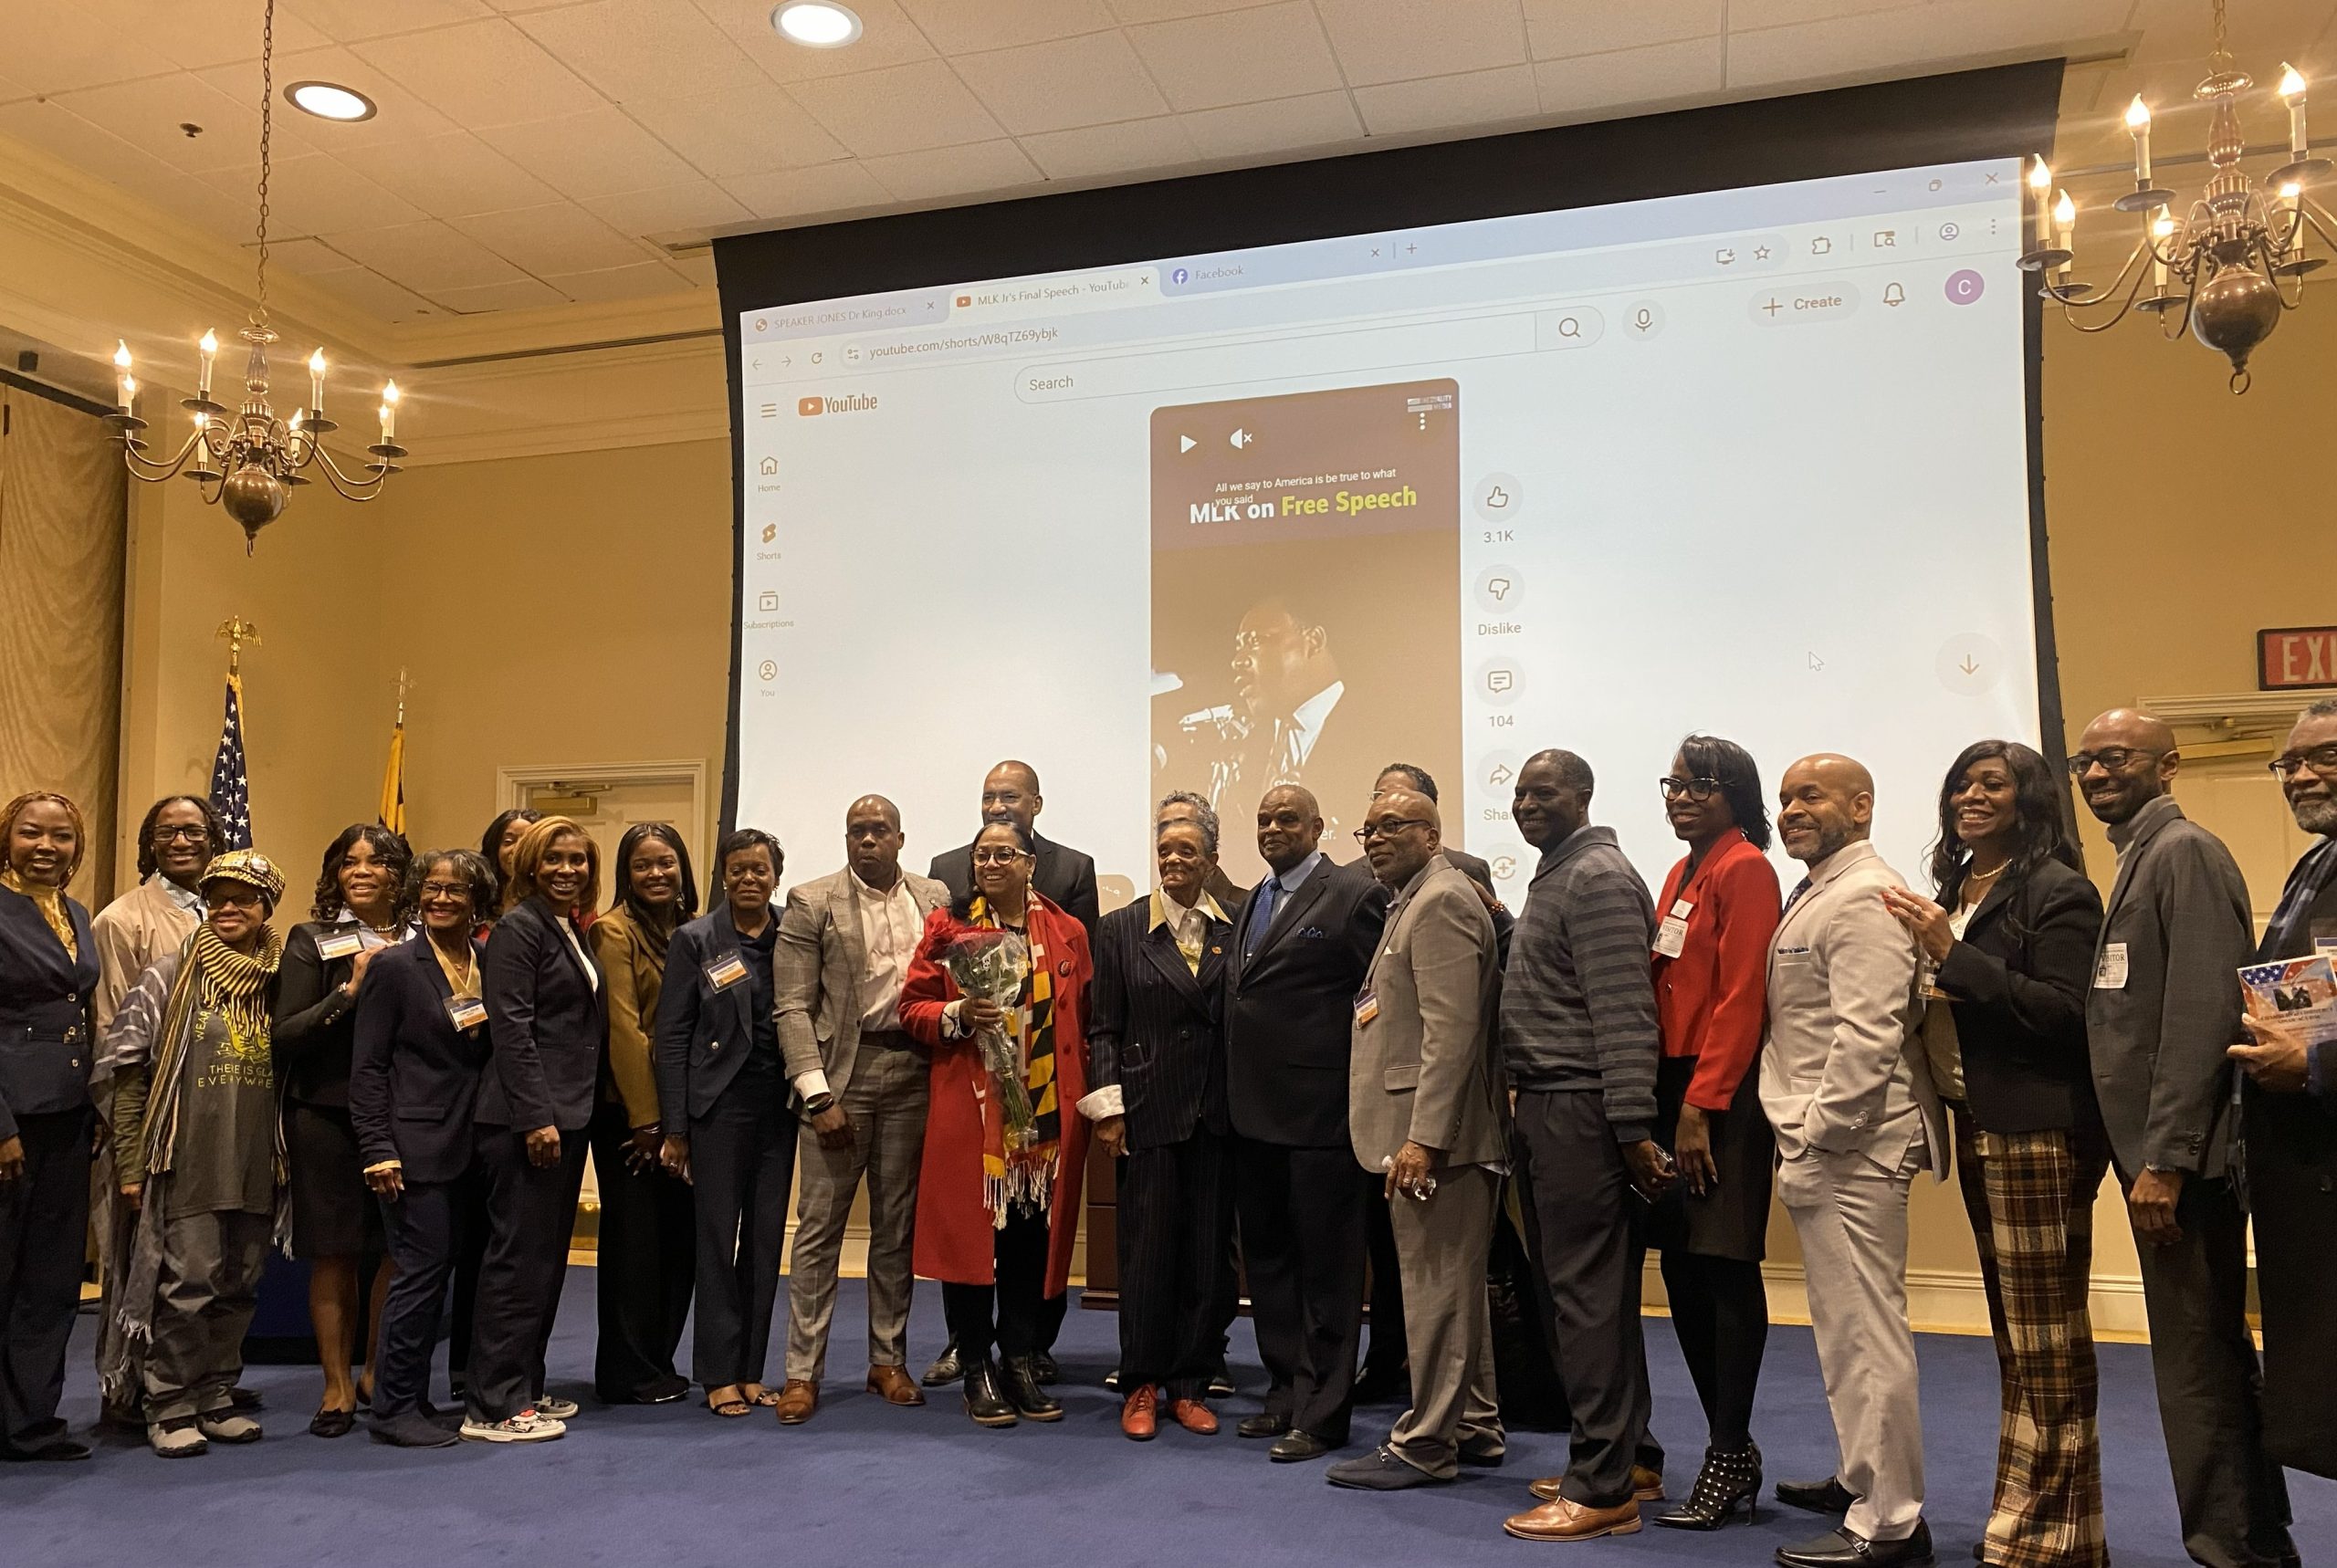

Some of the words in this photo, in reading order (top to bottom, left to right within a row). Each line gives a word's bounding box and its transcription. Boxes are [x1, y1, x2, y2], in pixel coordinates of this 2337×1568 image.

[1194, 265, 1244, 280] Facebook
[1957, 279, 1972, 296] C
[978, 294, 999, 306] MLK
[1001, 291, 1016, 303] Jr's
[1019, 288, 1042, 300] Final
[1043, 285, 1079, 299] Speech
[1793, 294, 1842, 310] Create
[774, 316, 814, 329] SPEAKER
[816, 311, 846, 325] JONES
[848, 310, 859, 320] Dr
[861, 306, 907, 319] King.docx
[1029, 375, 1074, 392] Search
[824, 392, 878, 413] YouTube
[1215, 482, 1228, 493] All
[1229, 483, 1243, 492] we
[1244, 481, 1261, 492] say
[1263, 479, 1273, 489] to
[1273, 476, 1313, 488] America
[1315, 475, 1324, 485] is
[1326, 474, 1337, 484] be
[1339, 472, 1358, 482] true
[1360, 471, 1371, 480] to
[1372, 468, 1397, 479] what
[757, 483, 781, 494] Home
[1189, 502, 1242, 524] MLK
[1247, 502, 1274, 519] on
[1282, 496, 1329, 517] Free
[1336, 486, 1417, 517] Speech
[1215, 497, 1232, 509] you
[1233, 494, 1253, 505] said
[1483, 529, 1514, 543] 3.1K
[756, 550, 782, 561] Shorts
[743, 619, 794, 631] Subscriptions
[1477, 622, 1522, 636] Dislike
[2281, 634, 2337, 682] EXI
[760, 688, 776, 698] You
[1489, 715, 1514, 728] 104
[1483, 808, 1514, 821] Shar
[194, 1010, 212, 1043] WEAR
[243, 1065, 254, 1075] IS
[256, 1066, 274, 1077] GLA
[197, 1074, 274, 1090] EVERYWHE
